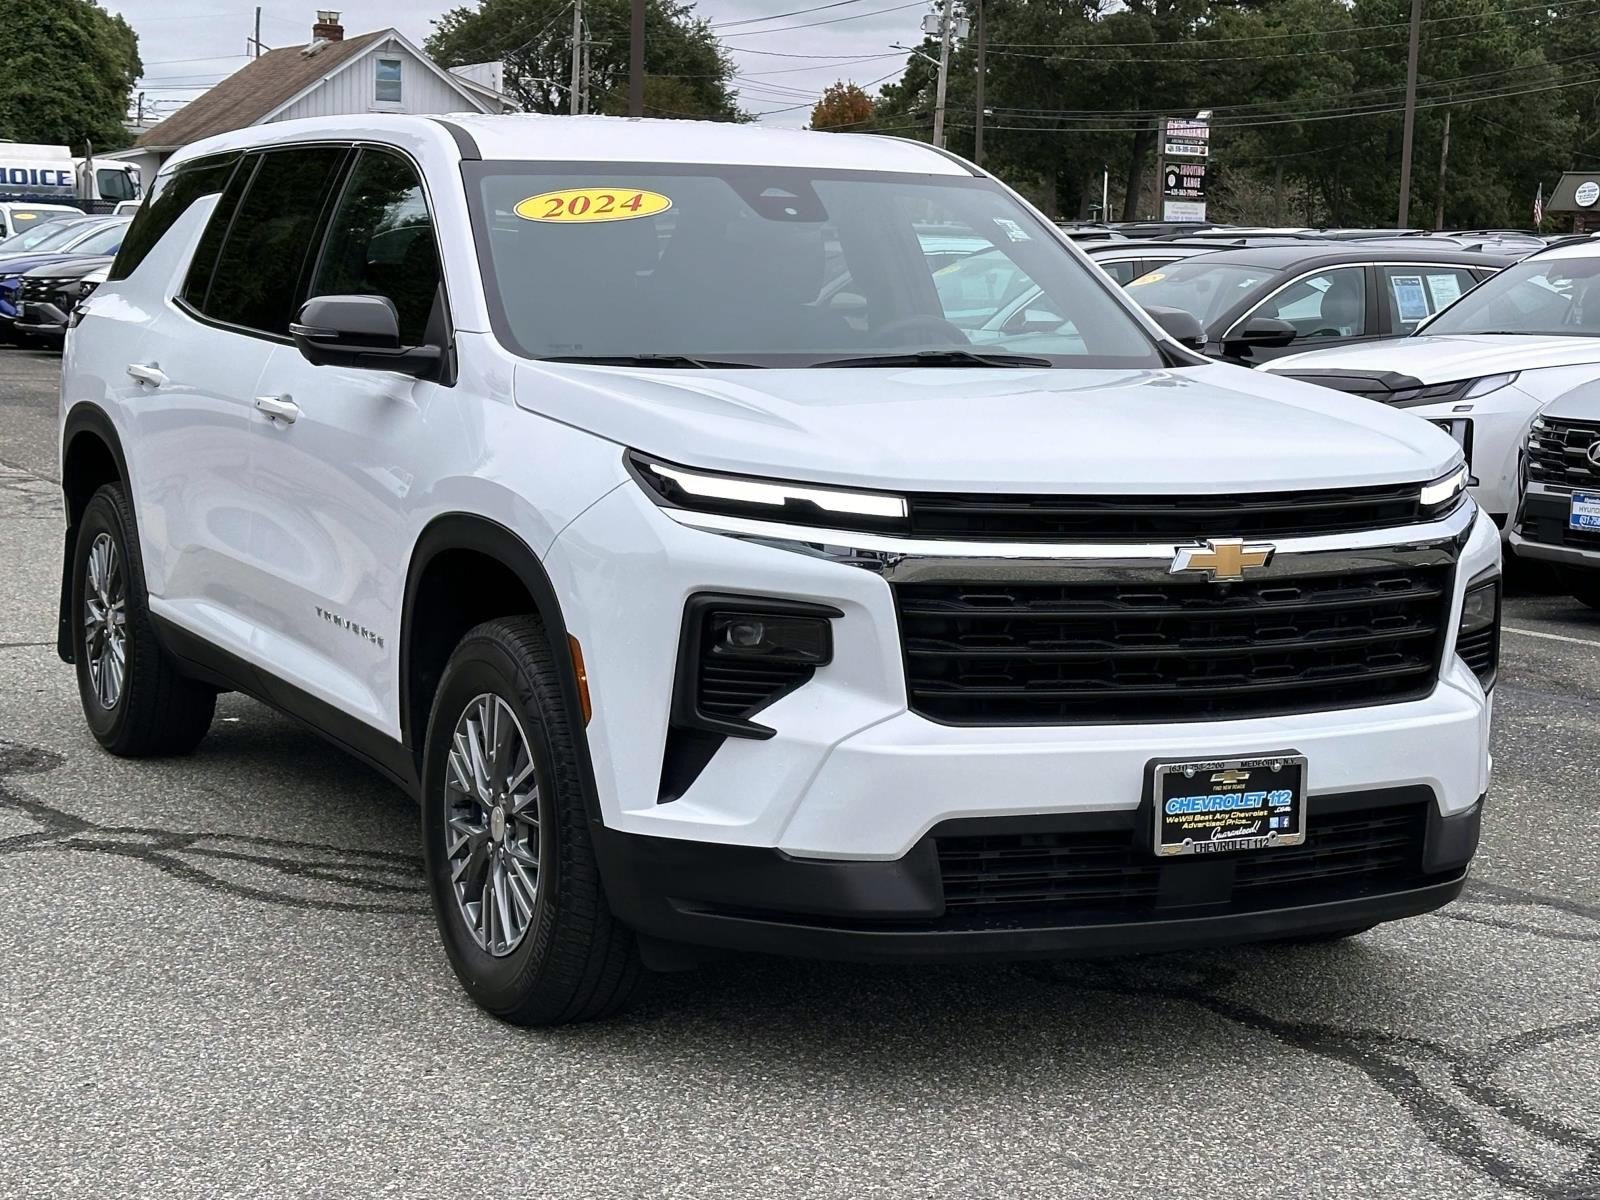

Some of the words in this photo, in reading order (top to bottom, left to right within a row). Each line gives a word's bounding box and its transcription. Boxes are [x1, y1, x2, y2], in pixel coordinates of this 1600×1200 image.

[1180, 164, 1205, 176] SHOOTING
[1183, 177, 1201, 188] RANGE
[542, 193, 643, 218] 2024
[315, 606, 384, 648] TRAVERSE
[1165, 791, 1266, 814] CHEVROLET
[1267, 790, 1292, 806] 112
[1194, 813, 1213, 822] Beat
[1214, 812, 1230, 821] Any
[1231, 810, 1268, 818] Chevrolet
[1182, 819, 1225, 830] Advertised
[1194, 839, 1251, 854] CHEVROLET
[1253, 838, 1269, 848] 112
